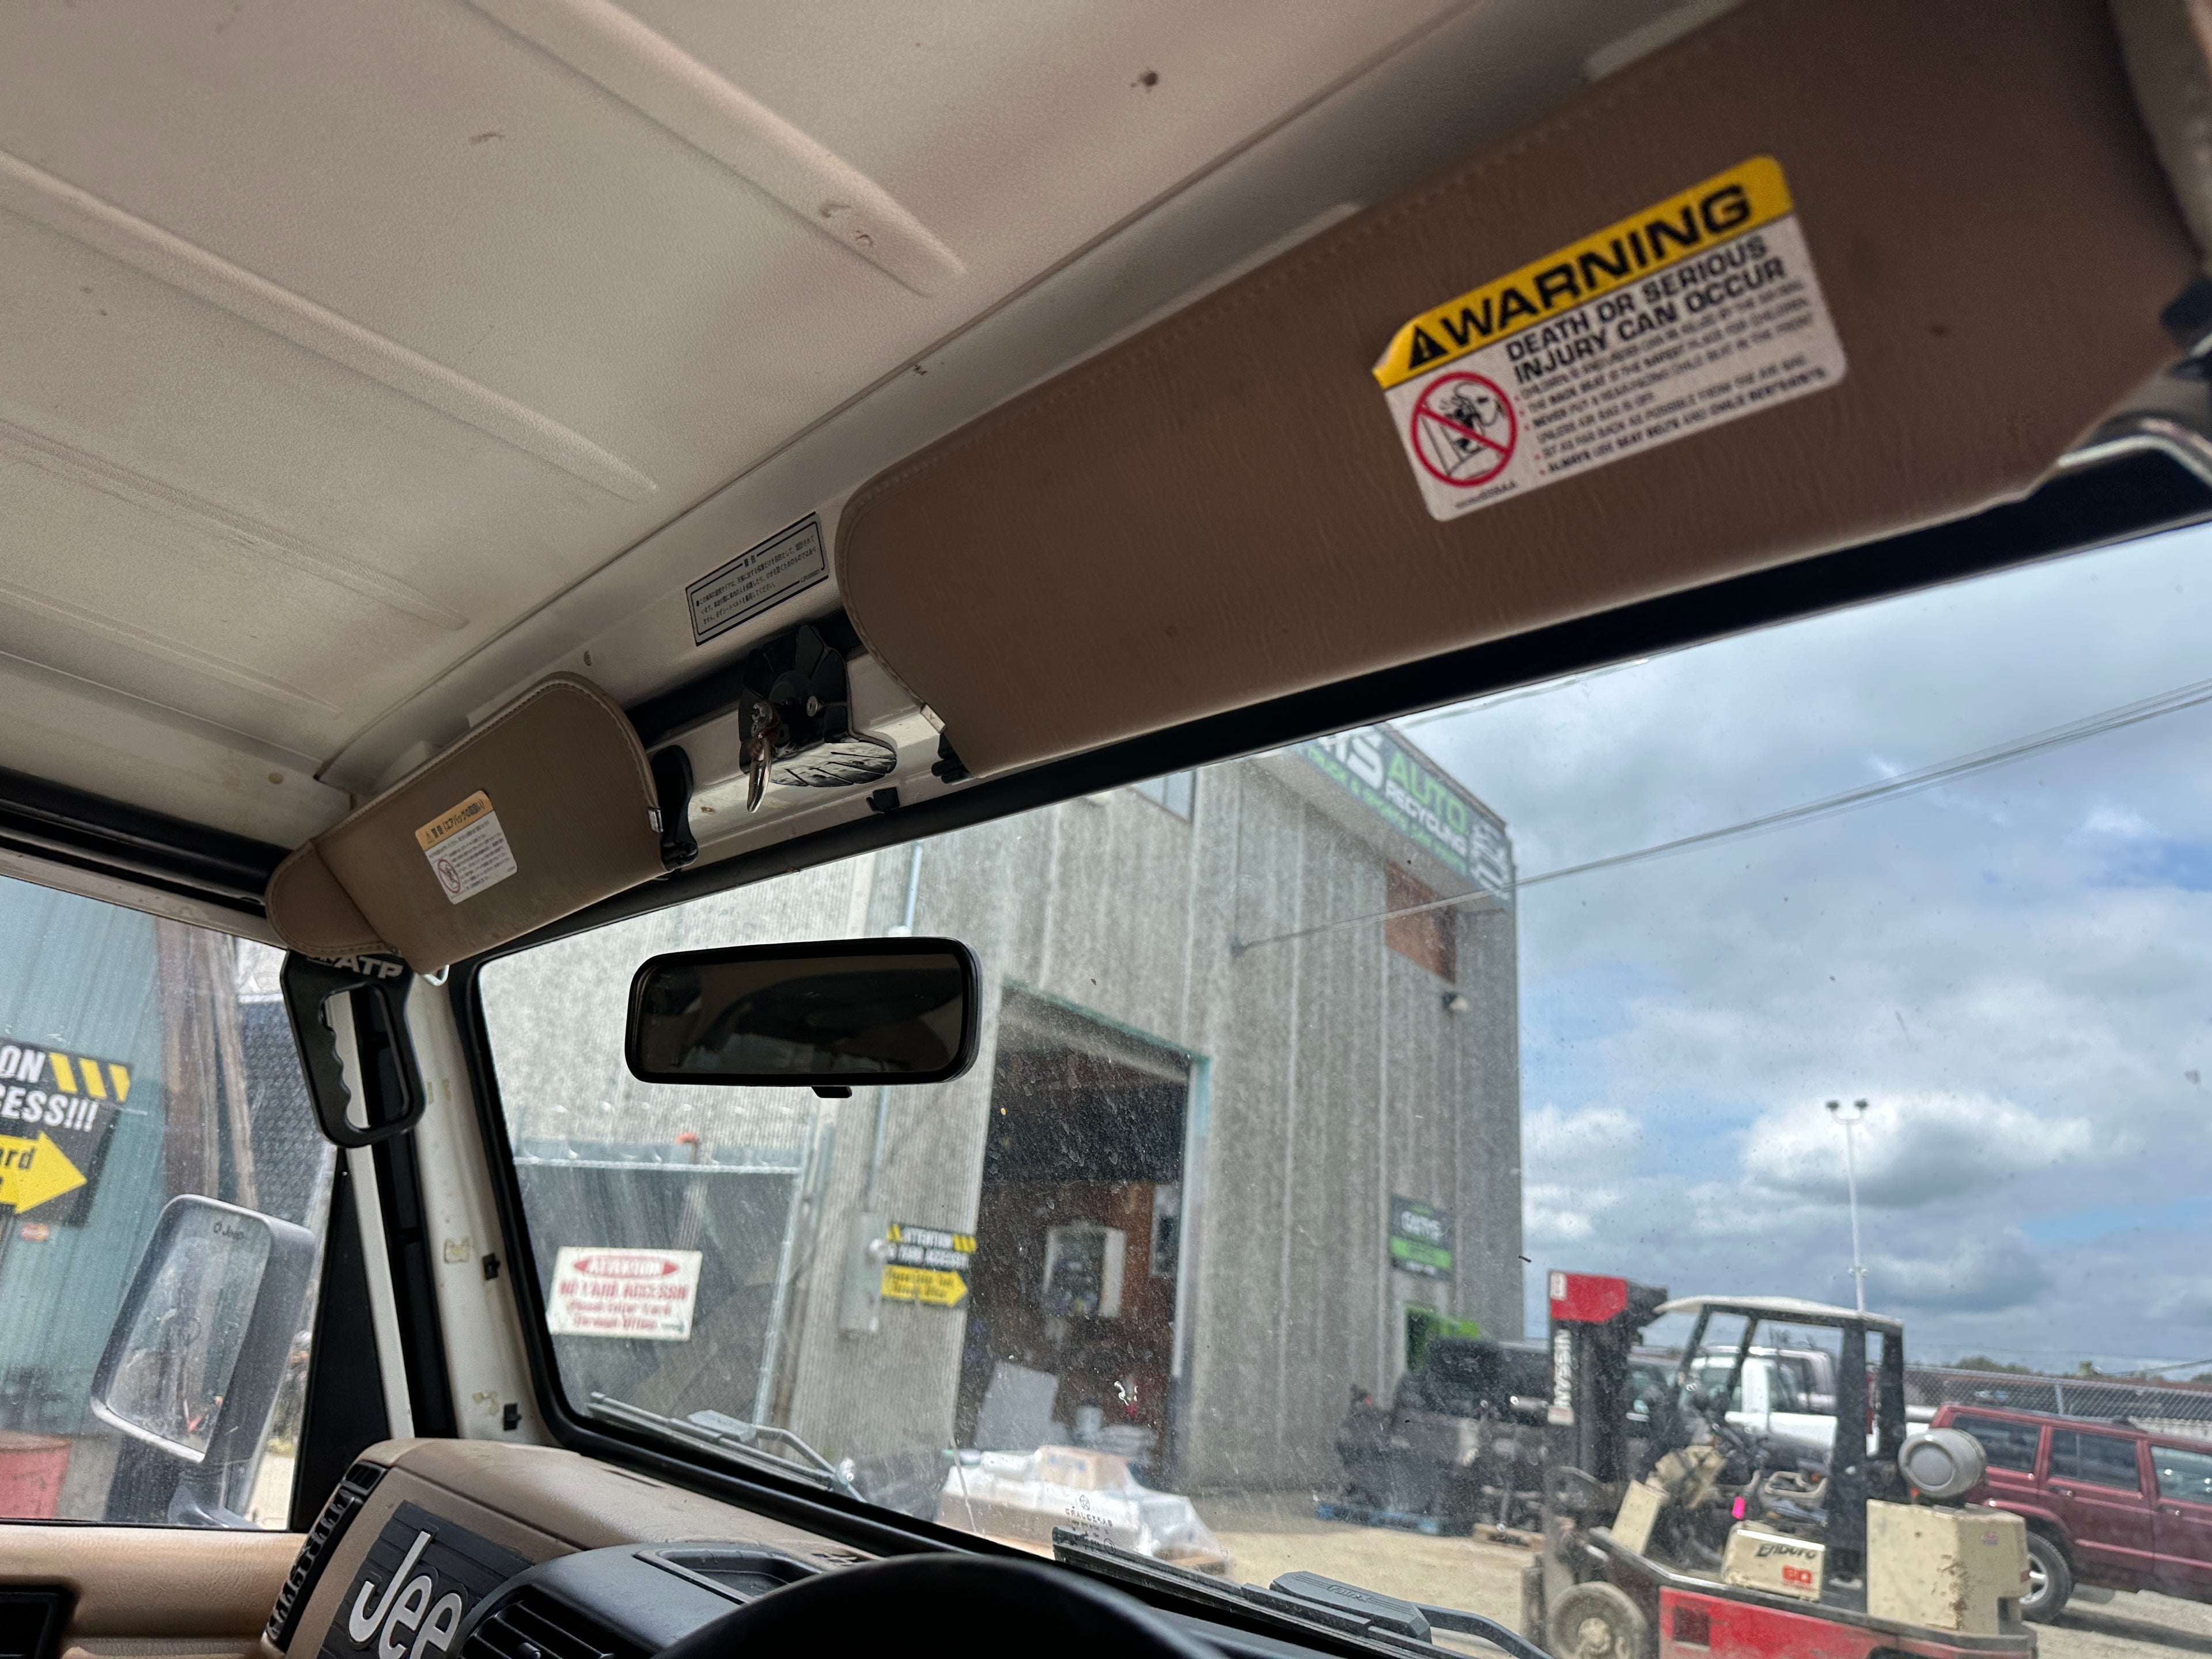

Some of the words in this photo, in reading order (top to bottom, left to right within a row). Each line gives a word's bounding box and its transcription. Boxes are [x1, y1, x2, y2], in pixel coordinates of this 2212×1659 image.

[1440, 184, 1751, 346] WARNING
[1504, 310, 1590, 362] DEATH
[1595, 291, 1635, 324] OR
[1640, 233, 1769, 305] SERIOUS
[1513, 328, 1611, 385] INJURY
[1615, 300, 1679, 343] CAN
[1683, 255, 1786, 315] OCCUR
[1528, 398, 1547, 414] THE
[1547, 386, 1578, 407] BACK
[1578, 375, 1606, 394] SEAT
[1642, 344, 1685, 369] SAFEST
[1686, 328, 1723, 353] PLACE
[1725, 319, 1748, 337] FOR
[1532, 407, 1567, 429] NEVER
[1569, 399, 1589, 415] PUT
[1673, 354, 1703, 375] CHILD
[1706, 343, 1733, 362] SEAT
[1749, 328, 1772, 346] THE
[1775, 312, 1814, 336] FRONT
[1536, 421, 1575, 444] UNLESS
[1577, 414, 1595, 429] AIR
[1597, 404, 1621, 421] BAG
[1547, 450, 1591, 474] ALWAYS
[1592, 442, 1614, 458] USE
[1616, 431, 1643, 449] SEAT
[1644, 418, 1680, 439] BELTS
[1596, 419, 1626, 439] BACK
[1644, 393, 1696, 422] POSSIBLE
[1696, 380, 1732, 402] FROM
[1385, 778, 1467, 857] RECYCLING
[1388, 750, 1466, 834] AUTO
[1554, 1329, 1572, 1407] NISSAN
